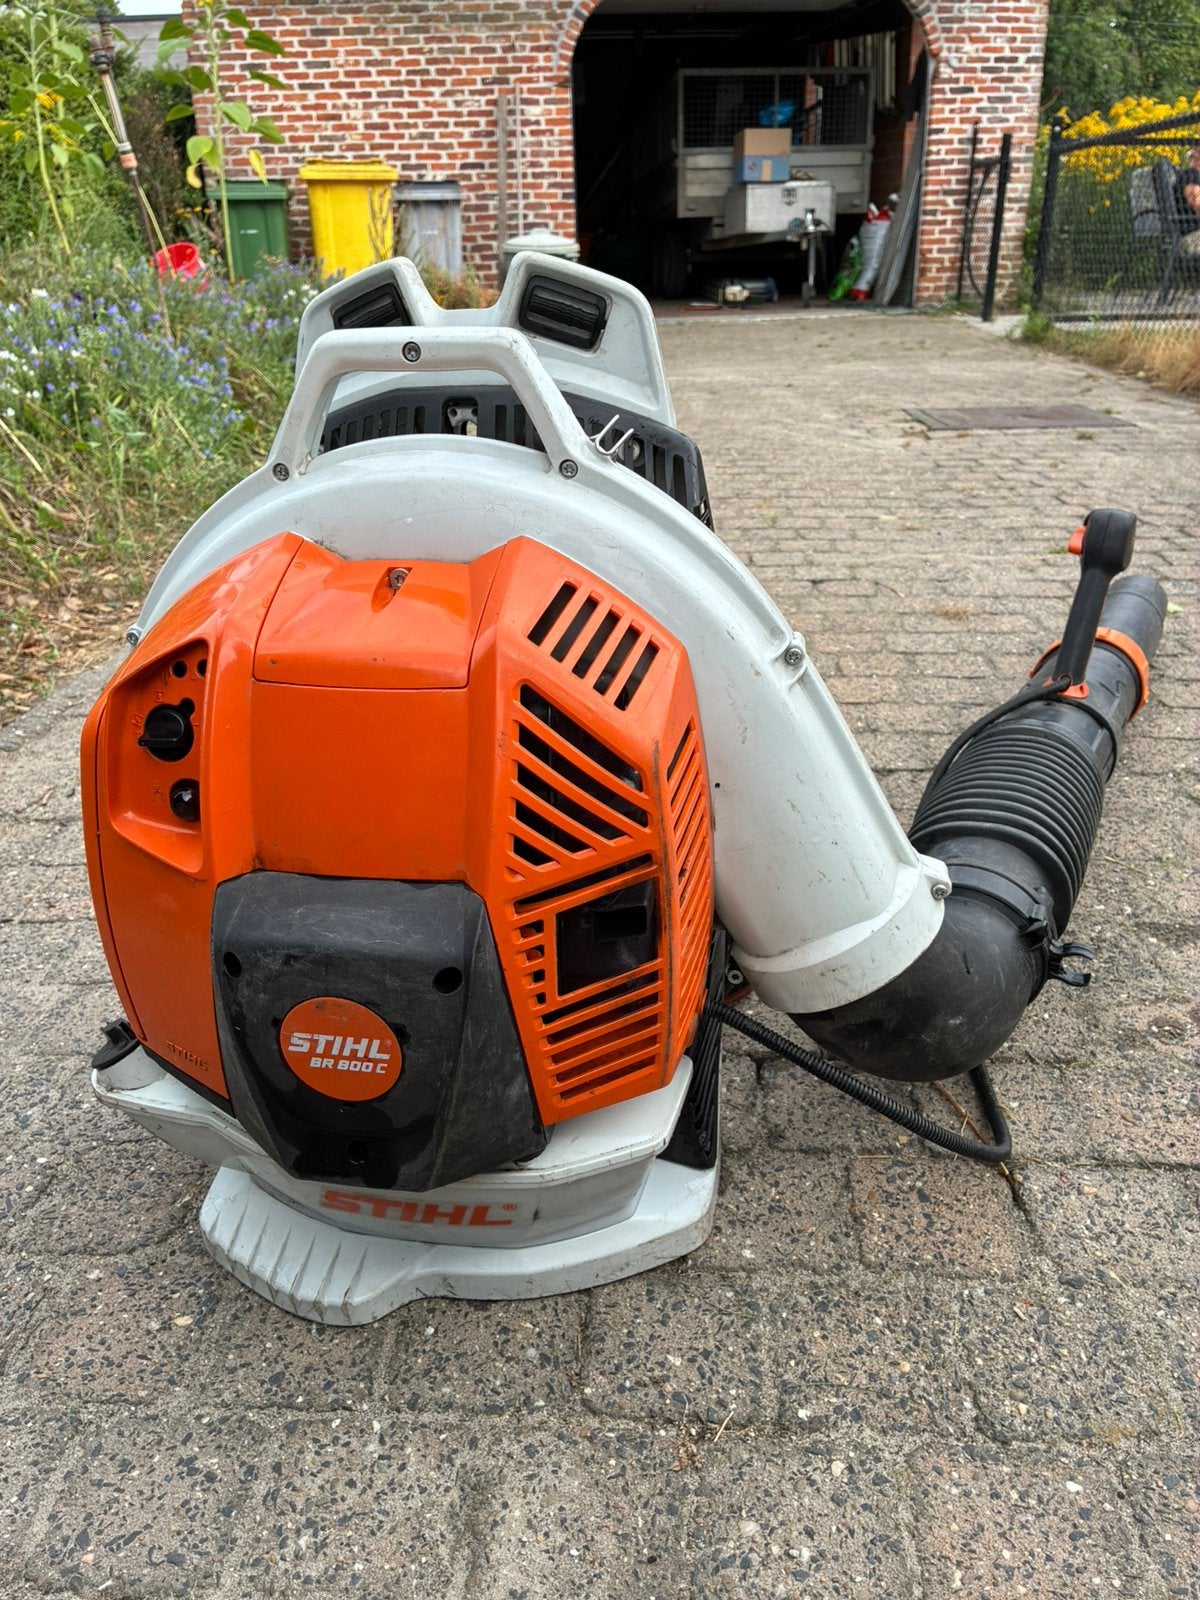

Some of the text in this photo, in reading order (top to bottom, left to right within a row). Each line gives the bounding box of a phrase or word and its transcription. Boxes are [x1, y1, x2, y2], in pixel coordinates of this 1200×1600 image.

[309, 1057, 388, 1074] BR 800 C
